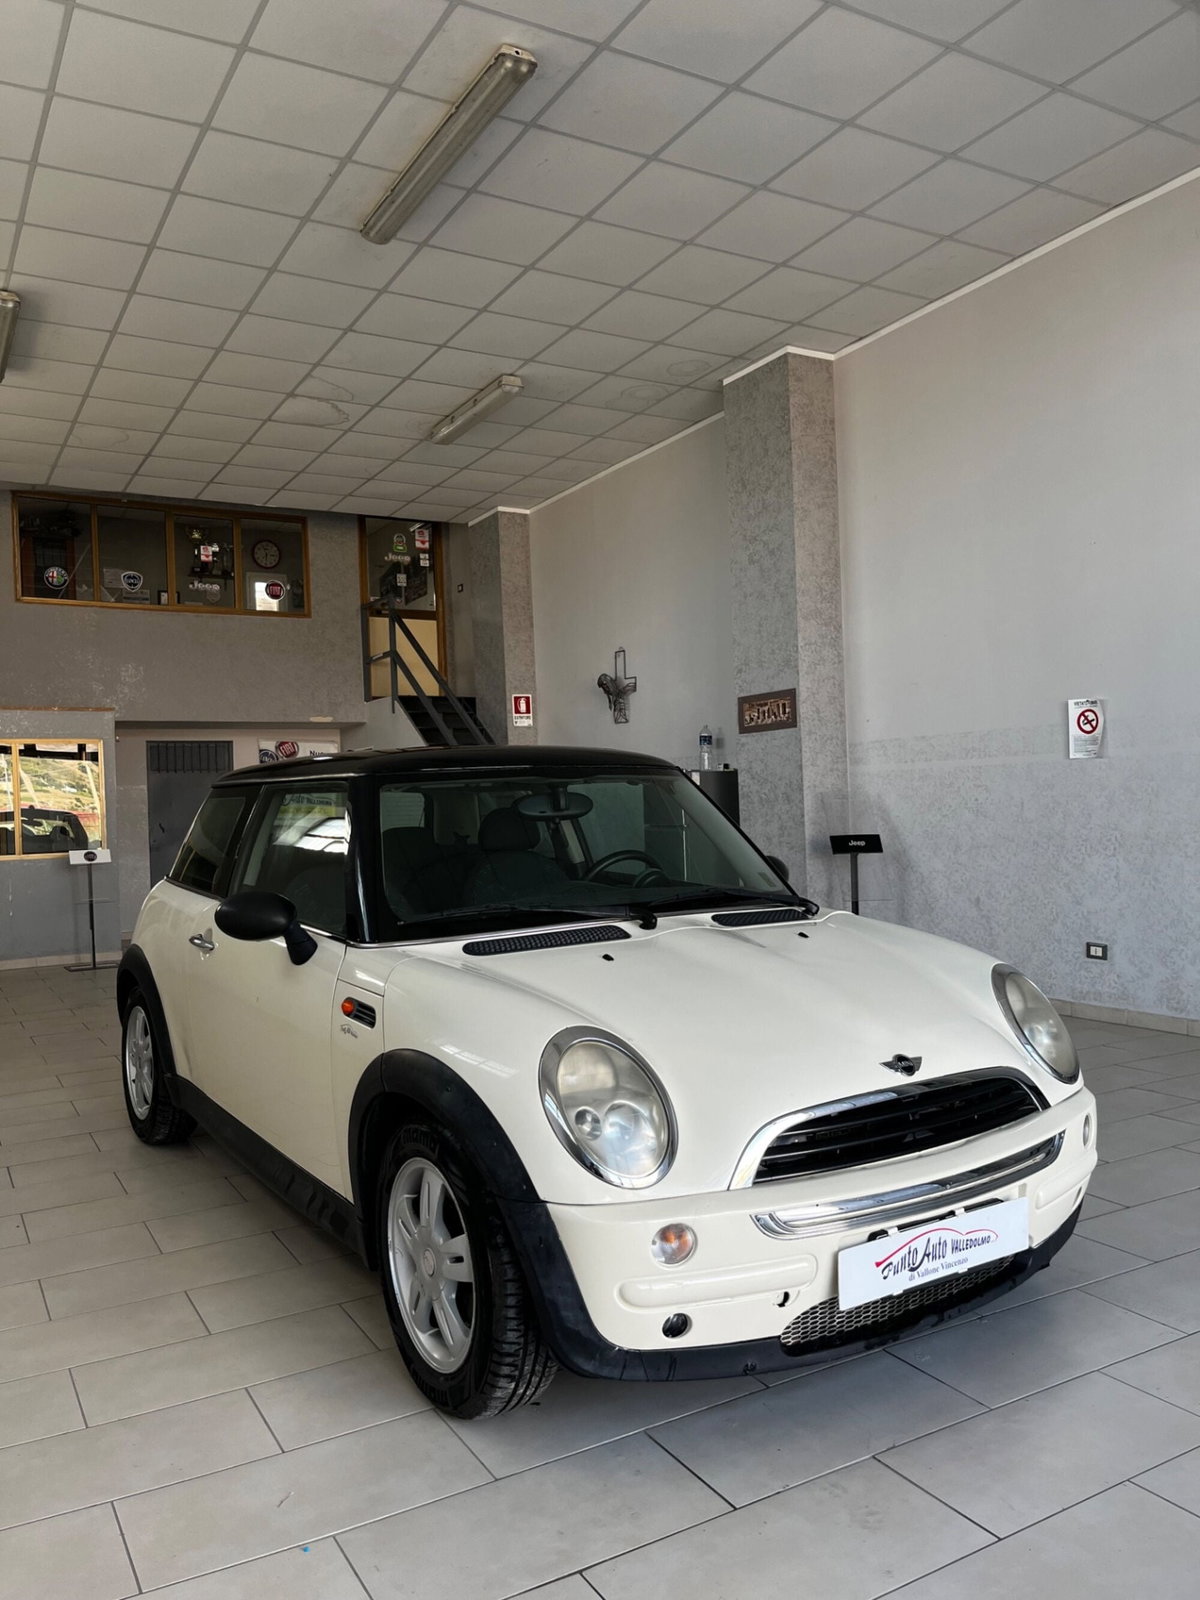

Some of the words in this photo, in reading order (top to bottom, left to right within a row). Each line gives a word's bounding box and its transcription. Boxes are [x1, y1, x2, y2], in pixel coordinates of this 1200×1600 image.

[188, 580, 220, 592] Jeep
[280, 742, 296, 756] FIAT
[848, 839, 866, 847] Jeep
[881, 1244, 919, 1280] Punto
[908, 1236, 947, 1272] Auto
[951, 1235, 991, 1254] VALLEDOLMO
[908, 1271, 917, 1281] di
[917, 1266, 940, 1279] Vallone
[942, 1257, 968, 1270] Vincenzo
